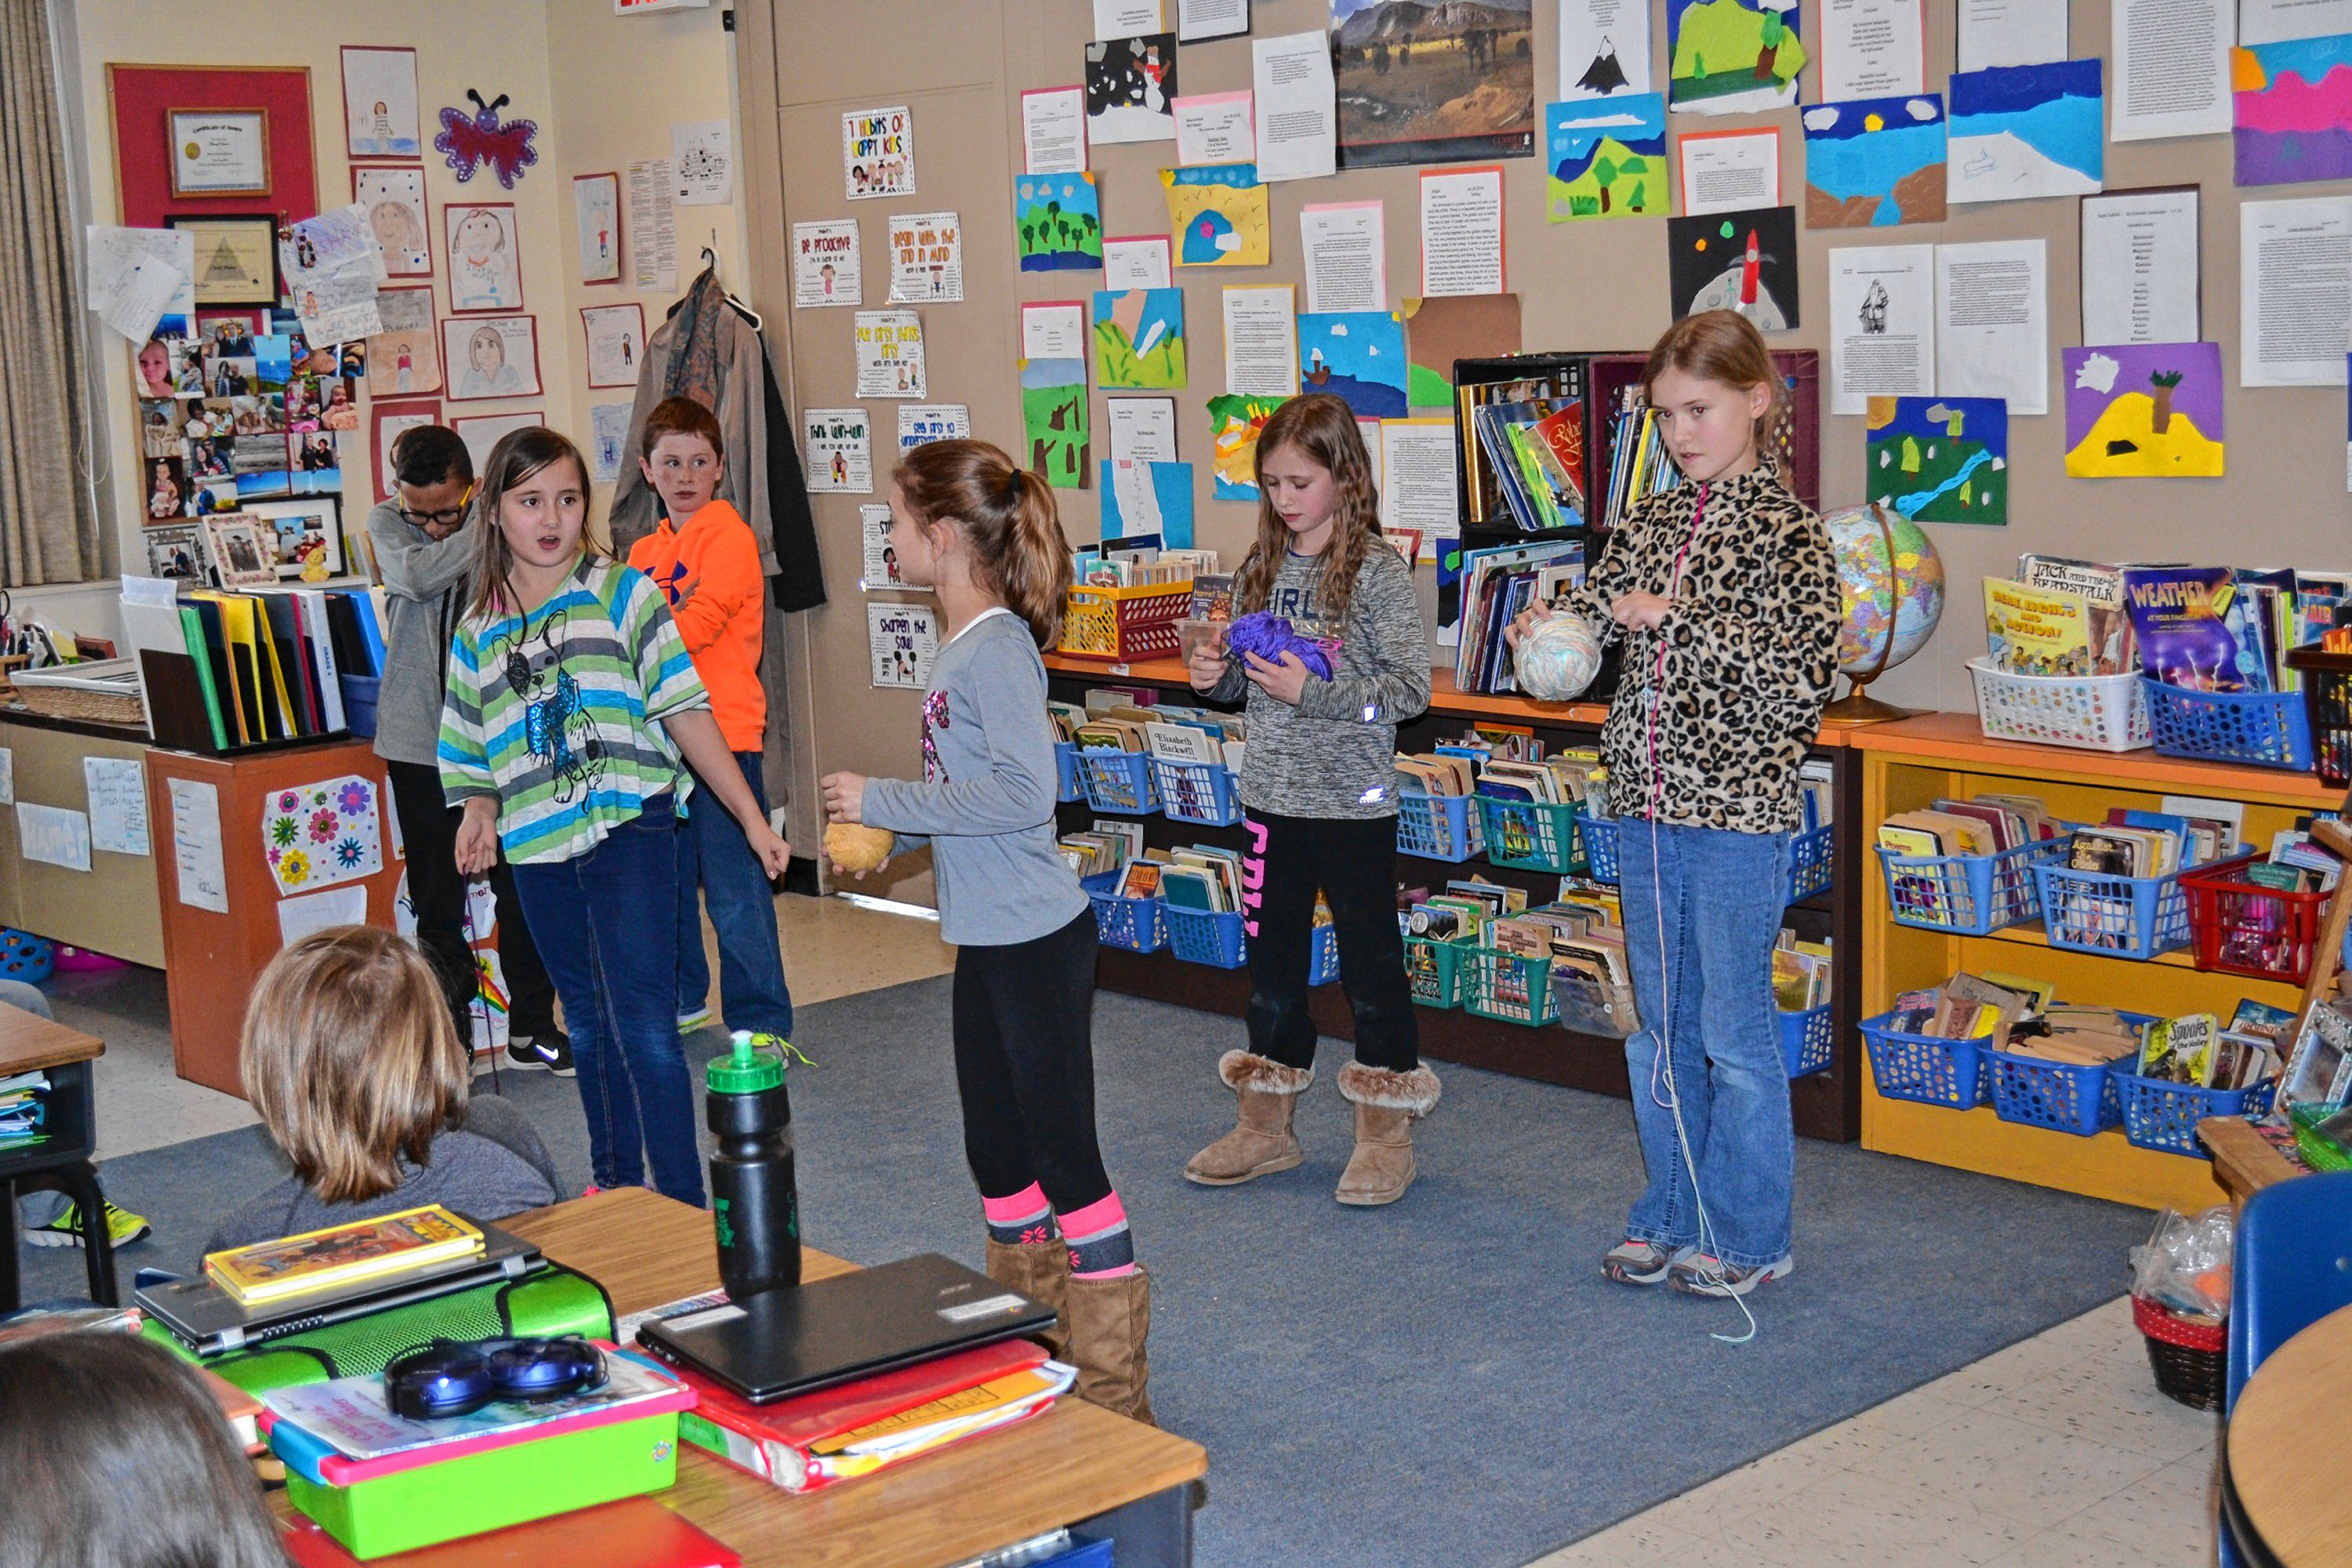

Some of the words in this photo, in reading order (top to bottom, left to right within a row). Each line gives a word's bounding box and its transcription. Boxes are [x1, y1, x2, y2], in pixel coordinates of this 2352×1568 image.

[848, 120, 855, 138] 7
[2033, 563, 2068, 579] JACK
[2068, 572, 2087, 583] AND
[2088, 575, 2104, 586] THE
[2129, 581, 2209, 608] WEATHER
[1154, 732, 1192, 746] Elizabeth
[1159, 742, 1195, 756] Blackwell
[1885, 840, 1912, 852] Poems
[2169, 1018, 2209, 1042] Spooks
